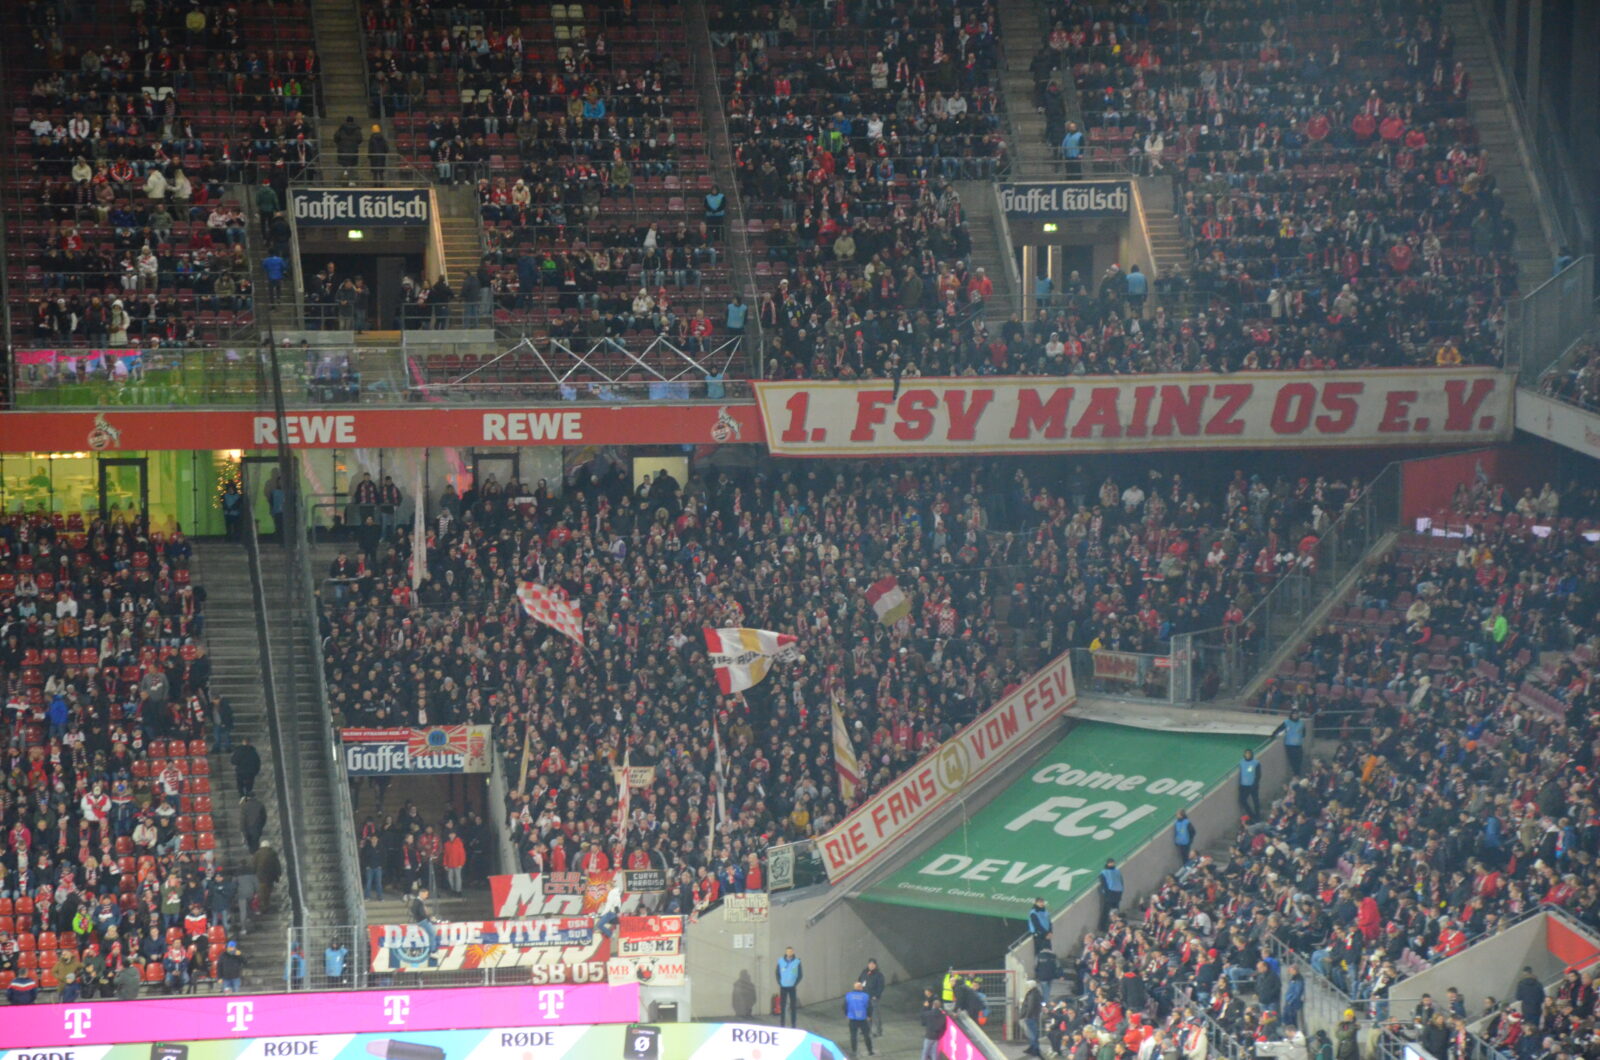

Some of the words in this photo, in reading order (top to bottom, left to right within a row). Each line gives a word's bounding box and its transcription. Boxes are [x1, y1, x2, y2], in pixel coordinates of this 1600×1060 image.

[295, 192, 356, 221] Gaffel
[359, 194, 428, 221] Kölsch
[1001, 186, 1059, 213] Gaffel
[1062, 186, 1128, 213] Kölsch
[483, 411, 583, 441] REWE
[781, 391, 826, 442] 1.
[850, 388, 994, 442] FSV
[1008, 384, 1253, 439] MAINZ
[253, 415, 356, 444] REWE
[347, 746, 411, 771] Gaffel
[825, 822, 868, 869] DIE
[871, 769, 937, 838] FANS
[970, 705, 1019, 760] VOM
[1023, 665, 1067, 722] FSV
[1032, 763, 1146, 791] Come
[1146, 777, 1205, 801] on,
[1004, 796, 1158, 840] FC!
[918, 854, 1092, 891] DEVK
[495, 918, 562, 943] VIVE
[264, 1041, 319, 1057] RØDE
[501, 1031, 554, 1048] RØDE
[732, 1028, 779, 1046] RØDE
